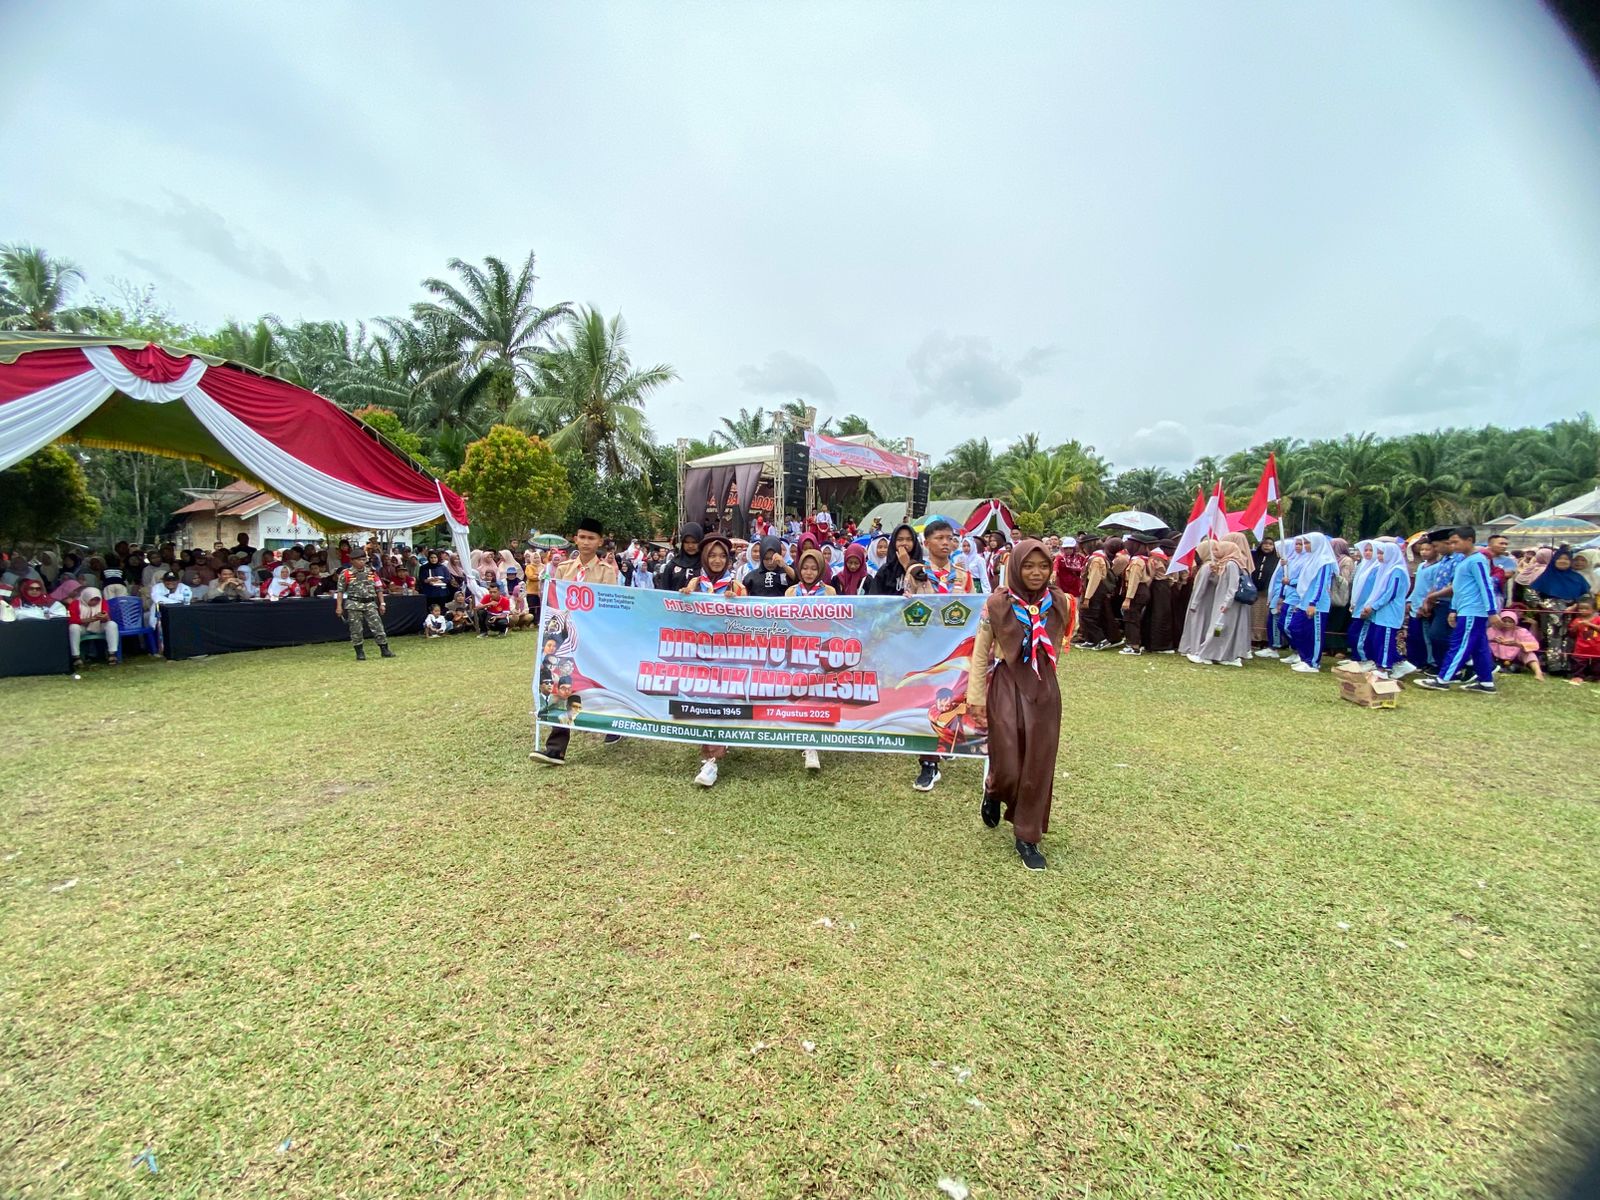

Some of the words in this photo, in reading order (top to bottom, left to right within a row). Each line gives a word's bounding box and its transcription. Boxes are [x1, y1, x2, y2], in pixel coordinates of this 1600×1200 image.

[565, 584, 595, 611] 80
[664, 598, 694, 612] MTs
[694, 601, 751, 617] NEGERI
[752, 604, 764, 618] 6
[766, 604, 854, 619] MERANGIN
[658, 627, 787, 664] DIRGAHAYU
[789, 635, 862, 670] KE-80
[637, 661, 749, 697] REPUBLIK
[749, 668, 880, 704] INDONESIA
[681, 705, 689, 713] 17
[690, 704, 721, 716] Agustus
[722, 707, 742, 716] 1945
[766, 708, 774, 716] 17
[775, 708, 809, 719] Agustus
[809, 710, 831, 719] 2025
[611, 719, 660, 733] #BERSATU
[660, 725, 717, 739] BERDAULAT,
[717, 730, 756, 741] RAKYAT
[757, 731, 820, 744] SEJAHTERA,
[821, 734, 875, 745] INDONESIA
[876, 736, 906, 747] MAJU
